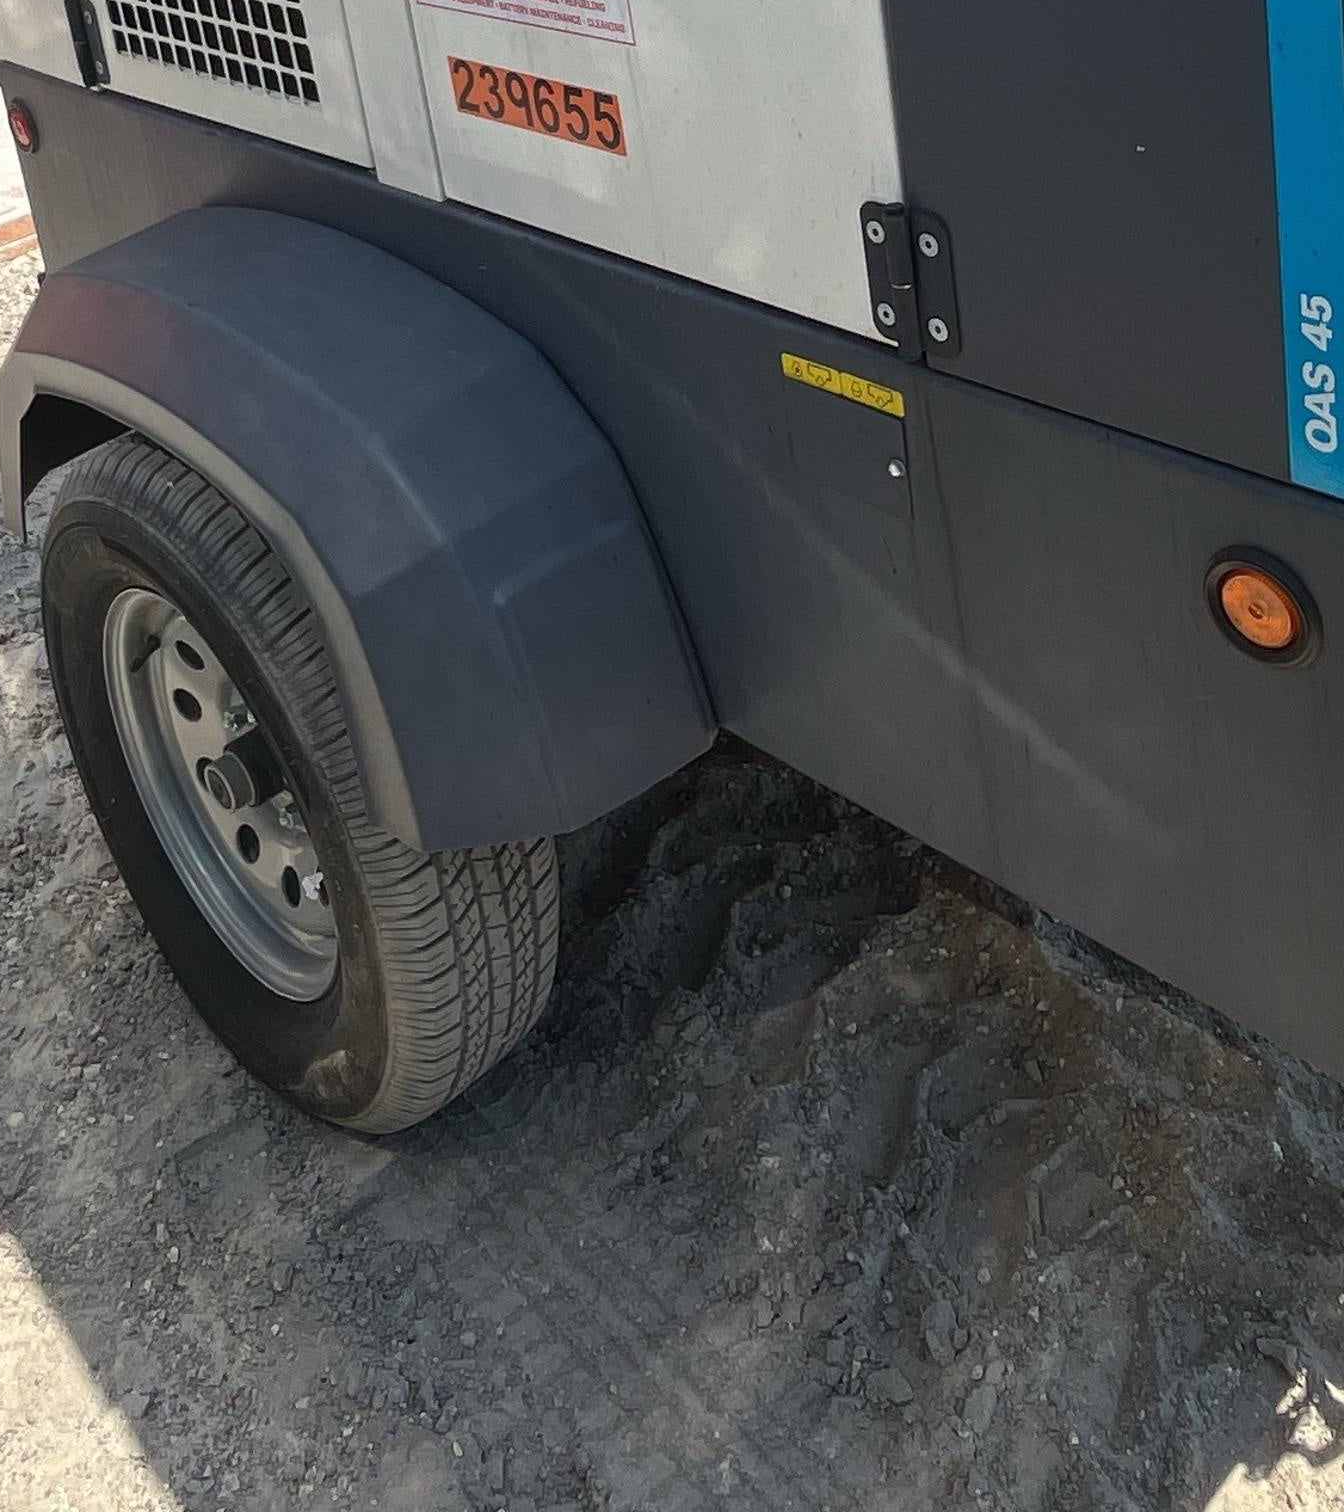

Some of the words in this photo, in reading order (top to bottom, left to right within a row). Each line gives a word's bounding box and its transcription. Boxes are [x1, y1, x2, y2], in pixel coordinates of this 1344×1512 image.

[453, 59, 622, 150] 239655
[1300, 293, 1333, 352] 45
[1304, 361, 1338, 454] QAS
